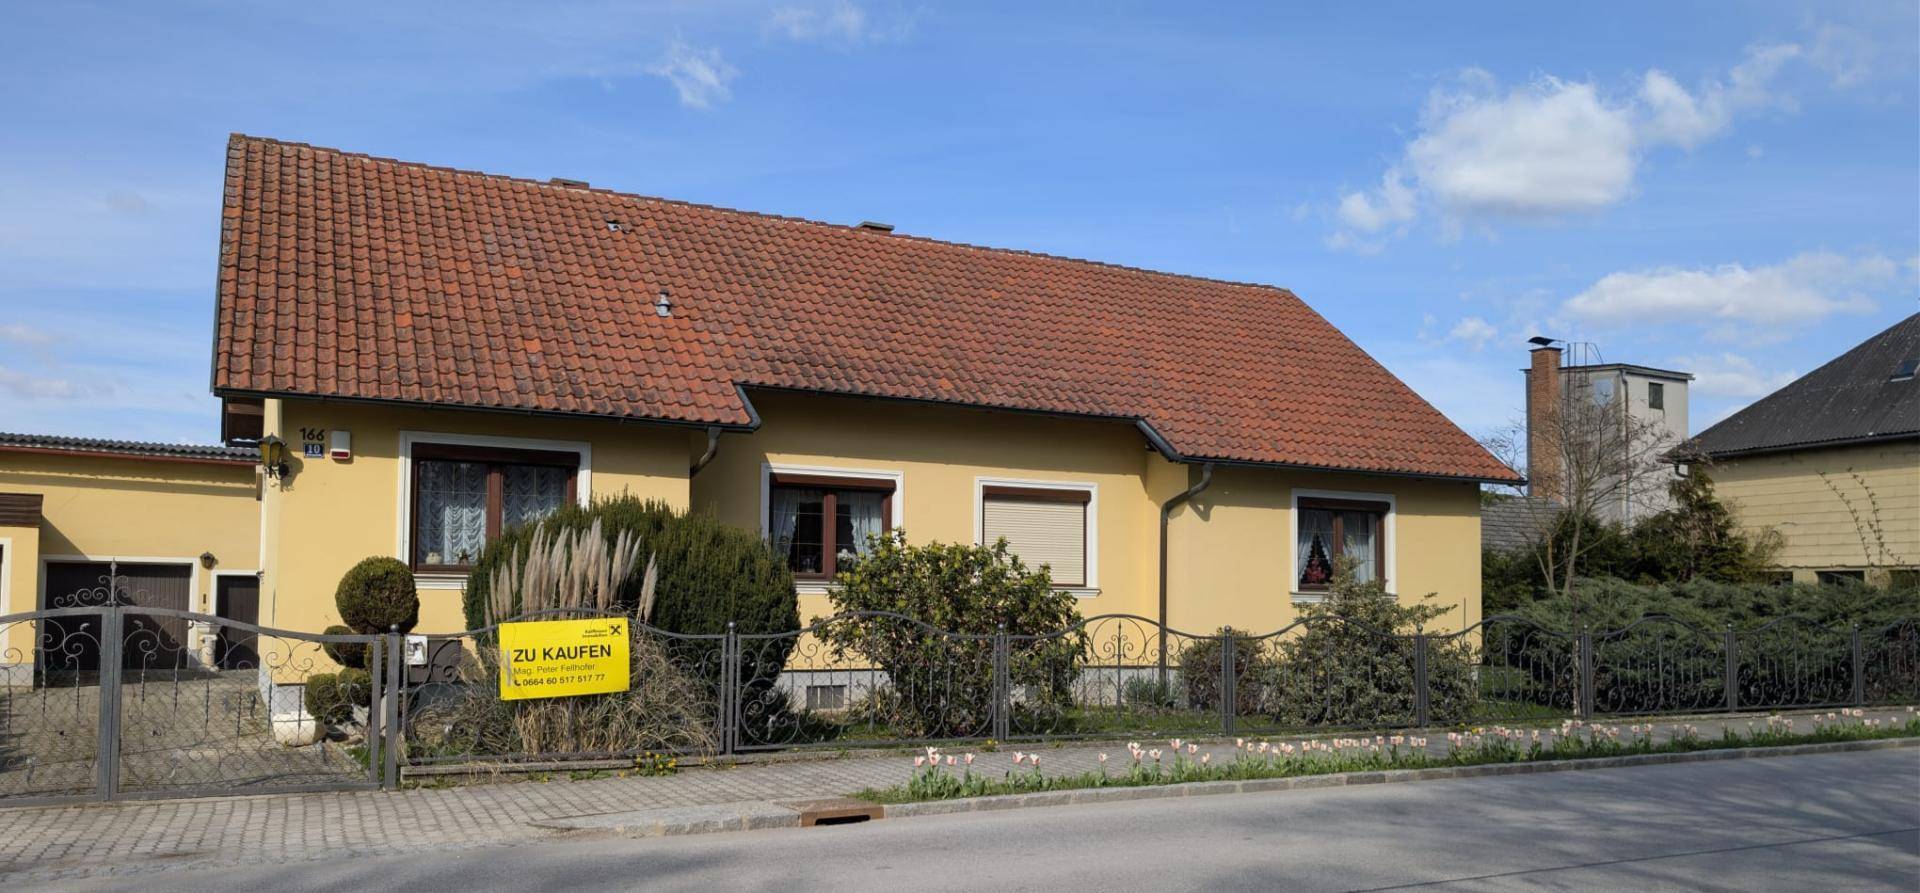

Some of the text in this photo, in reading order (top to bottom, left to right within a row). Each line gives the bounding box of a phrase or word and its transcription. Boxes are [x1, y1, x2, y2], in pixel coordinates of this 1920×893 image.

[299, 428, 325, 441] 166
[308, 445, 320, 454] 10
[513, 644, 611, 663] ZU KAUFEN
[514, 667, 533, 676] Mag.
[561, 663, 595, 672] Fellhofer
[522, 678, 544, 686] 0664
[559, 675, 575, 683] 517
[577, 674, 592, 682] 517
[595, 673, 605, 681] 77
